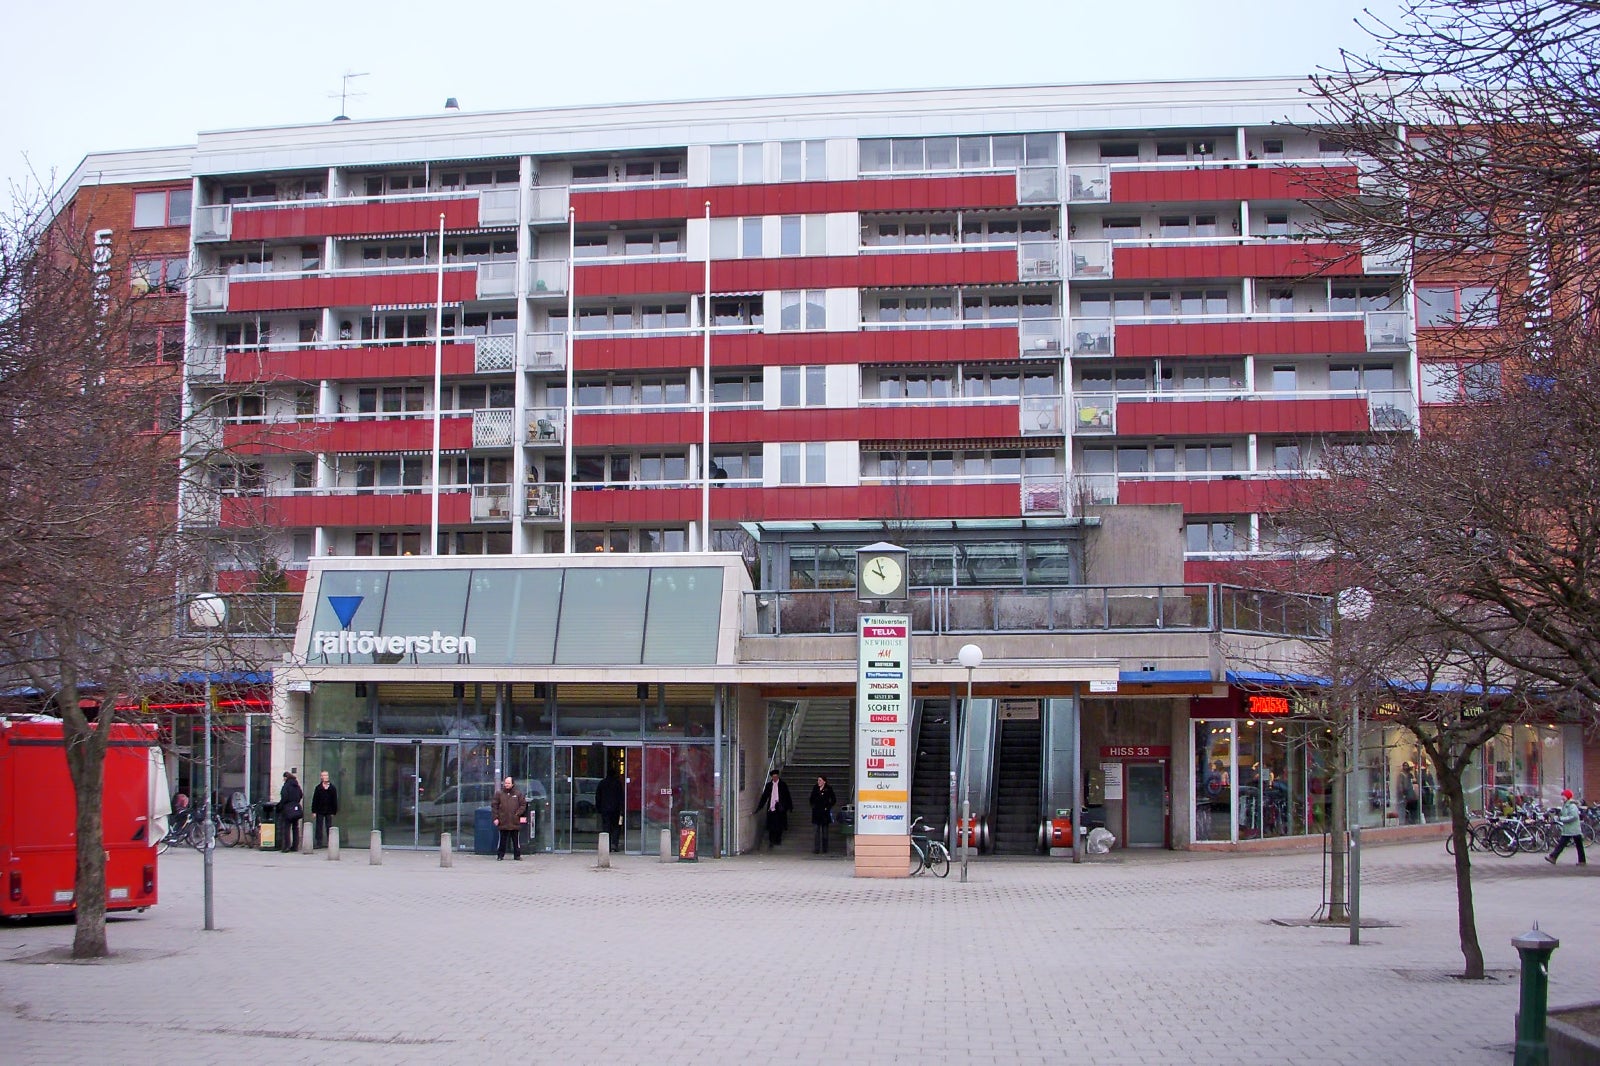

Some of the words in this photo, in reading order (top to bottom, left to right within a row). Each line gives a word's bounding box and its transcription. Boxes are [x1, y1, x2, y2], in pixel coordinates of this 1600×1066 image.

[871, 628, 898, 636] TELIA
[313, 630, 477, 654] fältöversten
[865, 639, 903, 647] NEWHOUSE
[1110, 747, 1134, 756] HISS
[1137, 747, 1150, 756] 33
